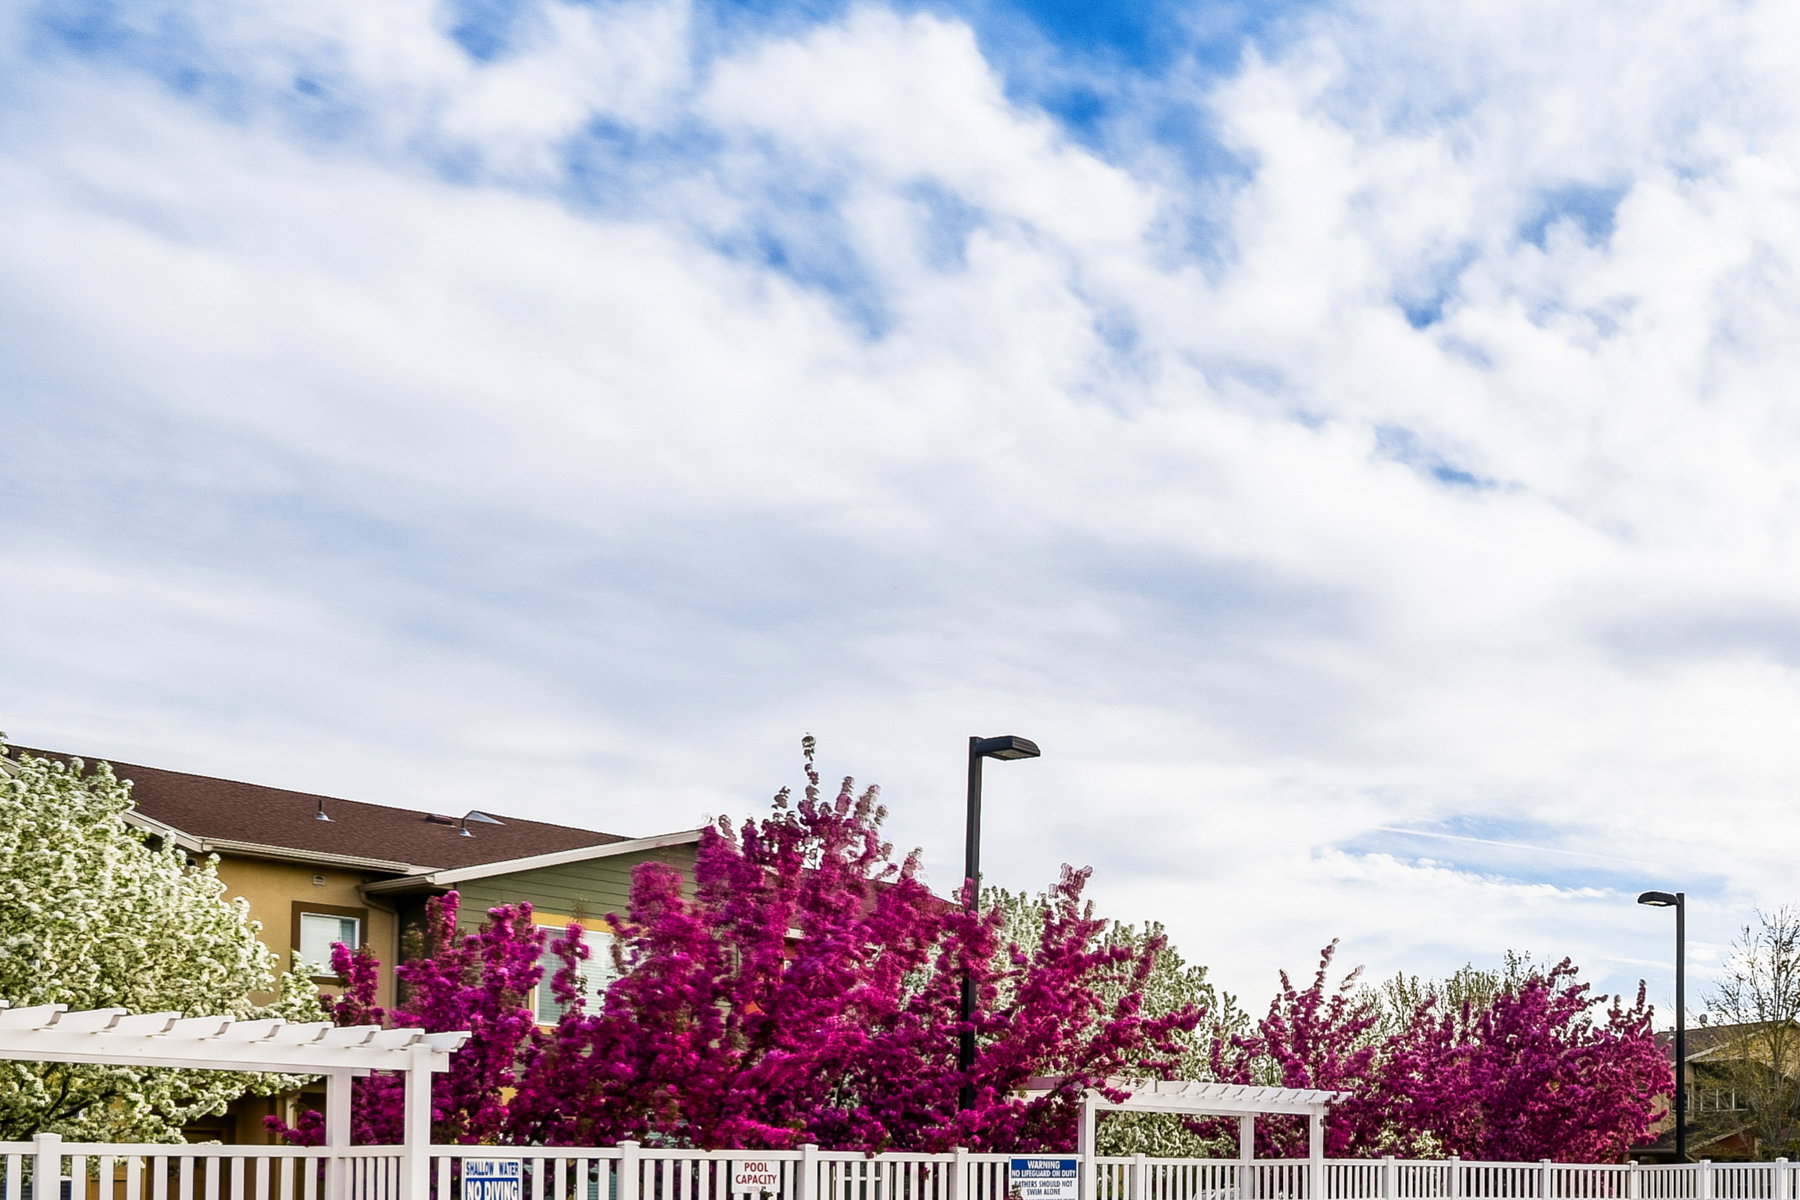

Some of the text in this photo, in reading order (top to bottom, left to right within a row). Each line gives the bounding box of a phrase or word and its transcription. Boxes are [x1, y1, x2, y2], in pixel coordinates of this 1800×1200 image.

[466, 1162, 518, 1175] SHALLOW WATER
[744, 1162, 768, 1172] POOL
[1027, 1161, 1060, 1169] WARNING
[736, 1175, 777, 1184] CAPACITY
